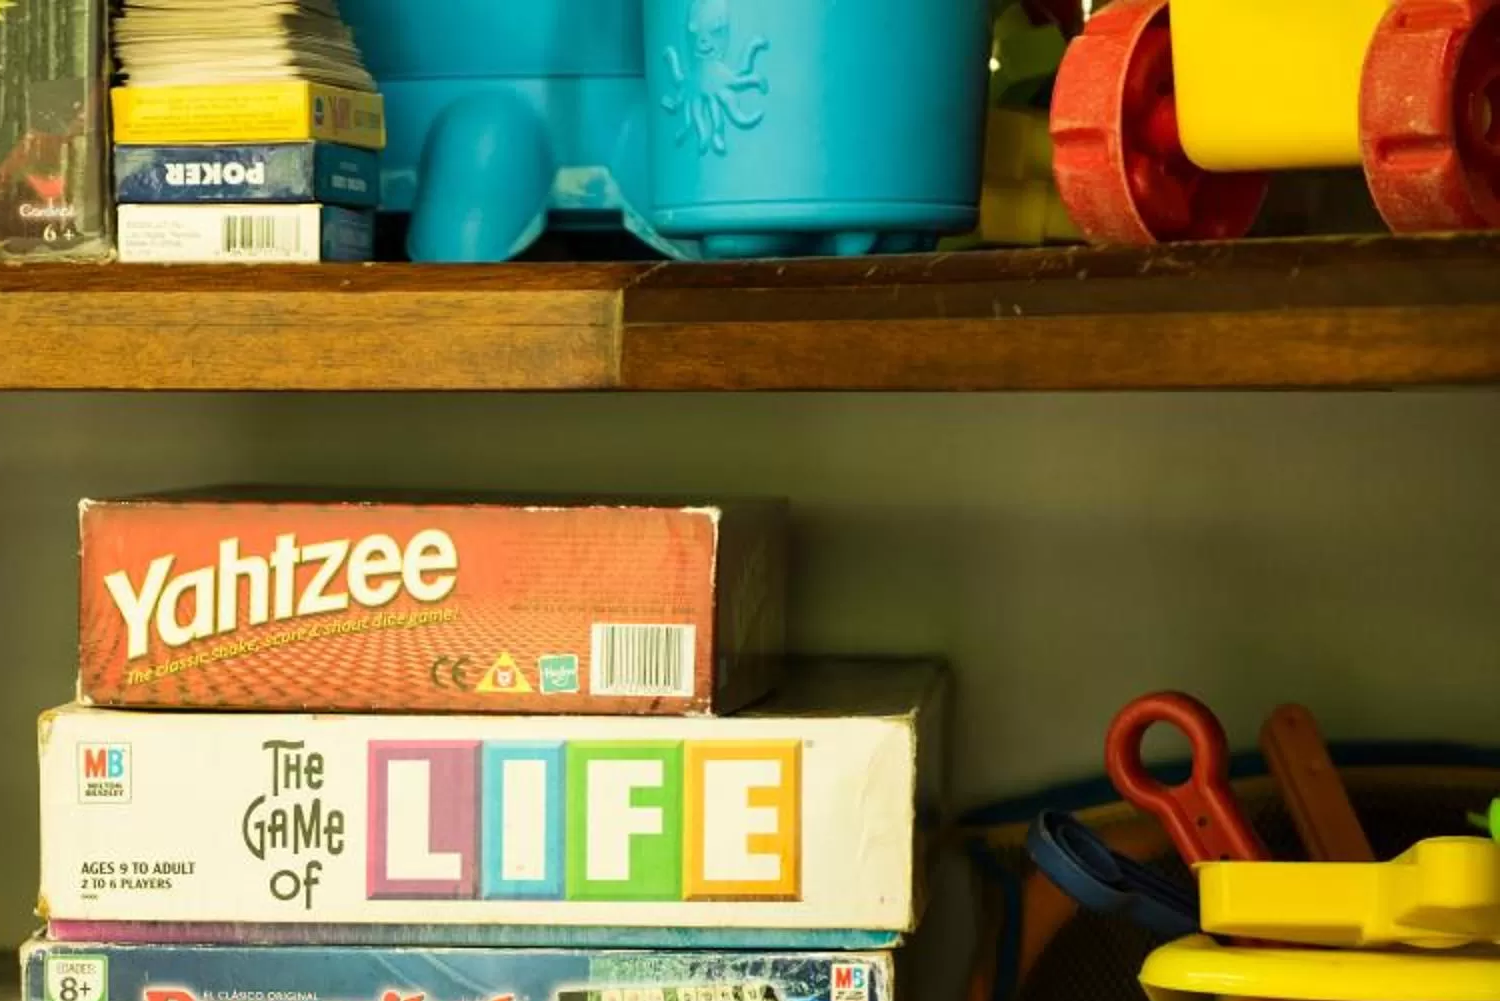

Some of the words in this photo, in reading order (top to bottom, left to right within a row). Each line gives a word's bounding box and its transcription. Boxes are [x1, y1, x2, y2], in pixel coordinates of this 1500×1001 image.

[165, 161, 265, 185] POKER
[105, 528, 459, 660] Yahtzee
[126, 669, 154, 685] The
[154, 652, 209, 678] classic
[84, 748, 125, 778] MB
[386, 759, 782, 881] LIFE
[81, 862, 115, 875] AGES
[119, 862, 128, 875] 9
[133, 862, 149, 875] TO
[152, 862, 195, 875] ADULT
[81, 878, 88, 888] 2
[92, 878, 106, 889] TO
[120, 878, 172, 889] PLAYERS
[203, 991, 214, 1000] EL
[266, 991, 318, 1001] ORIGINAL
